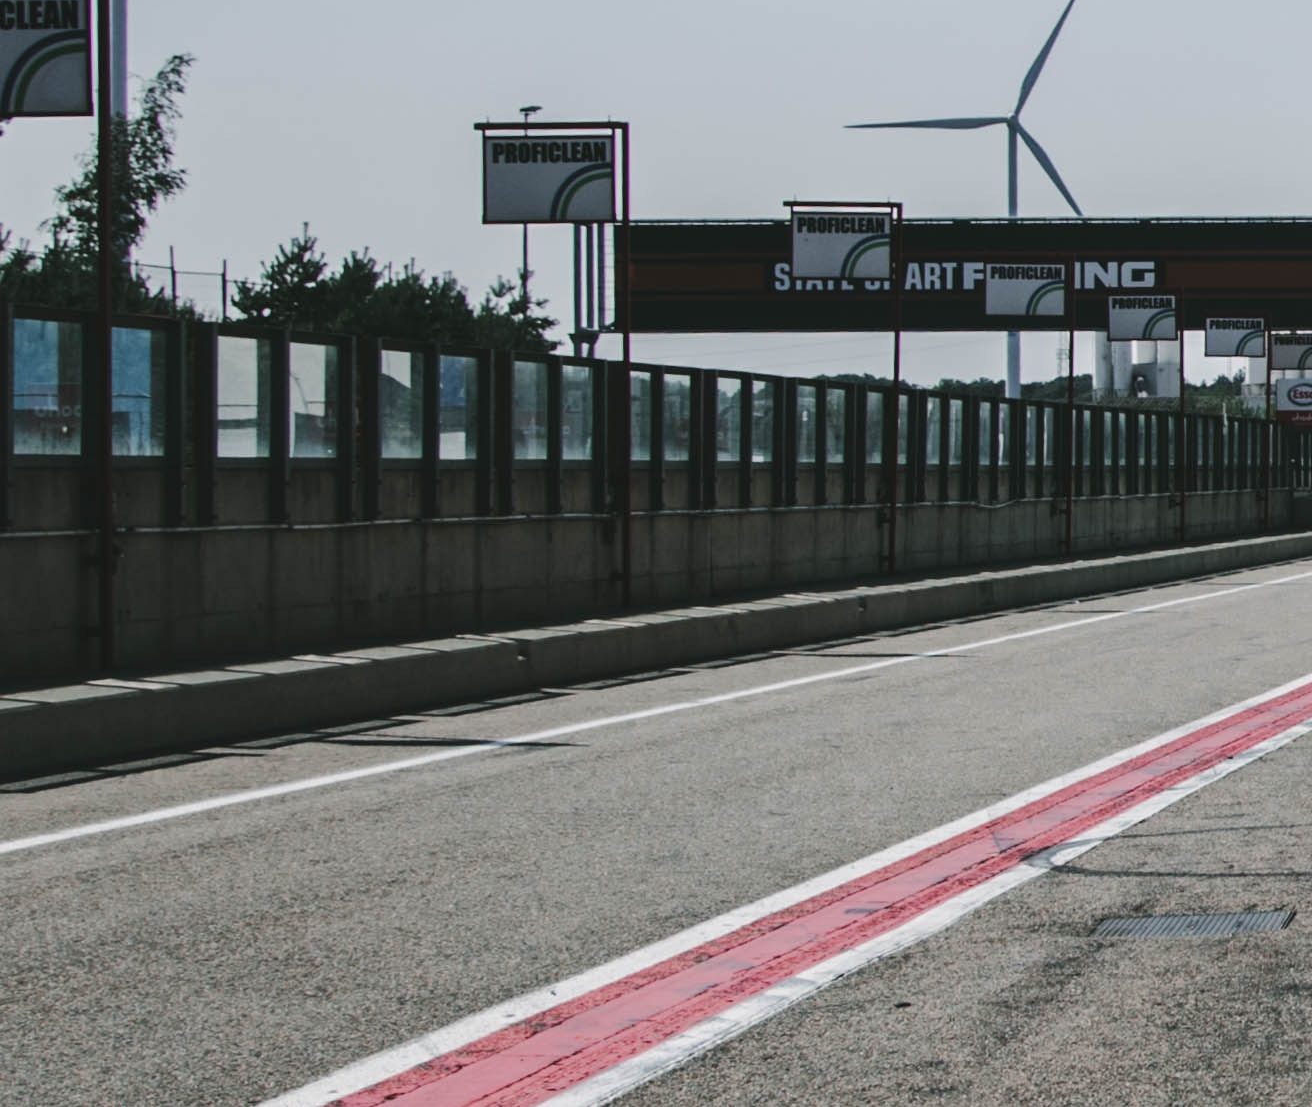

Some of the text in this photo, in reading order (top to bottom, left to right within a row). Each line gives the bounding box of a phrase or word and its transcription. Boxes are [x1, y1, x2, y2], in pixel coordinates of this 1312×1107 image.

[492, 141, 607, 163] PROFICLEAN
[797, 216, 885, 234] PROFICLEAN
[904, 261, 957, 291] ART
[990, 266, 1062, 281] PROFICLEAN
[1111, 297, 1173, 310] PROFICLEAN
